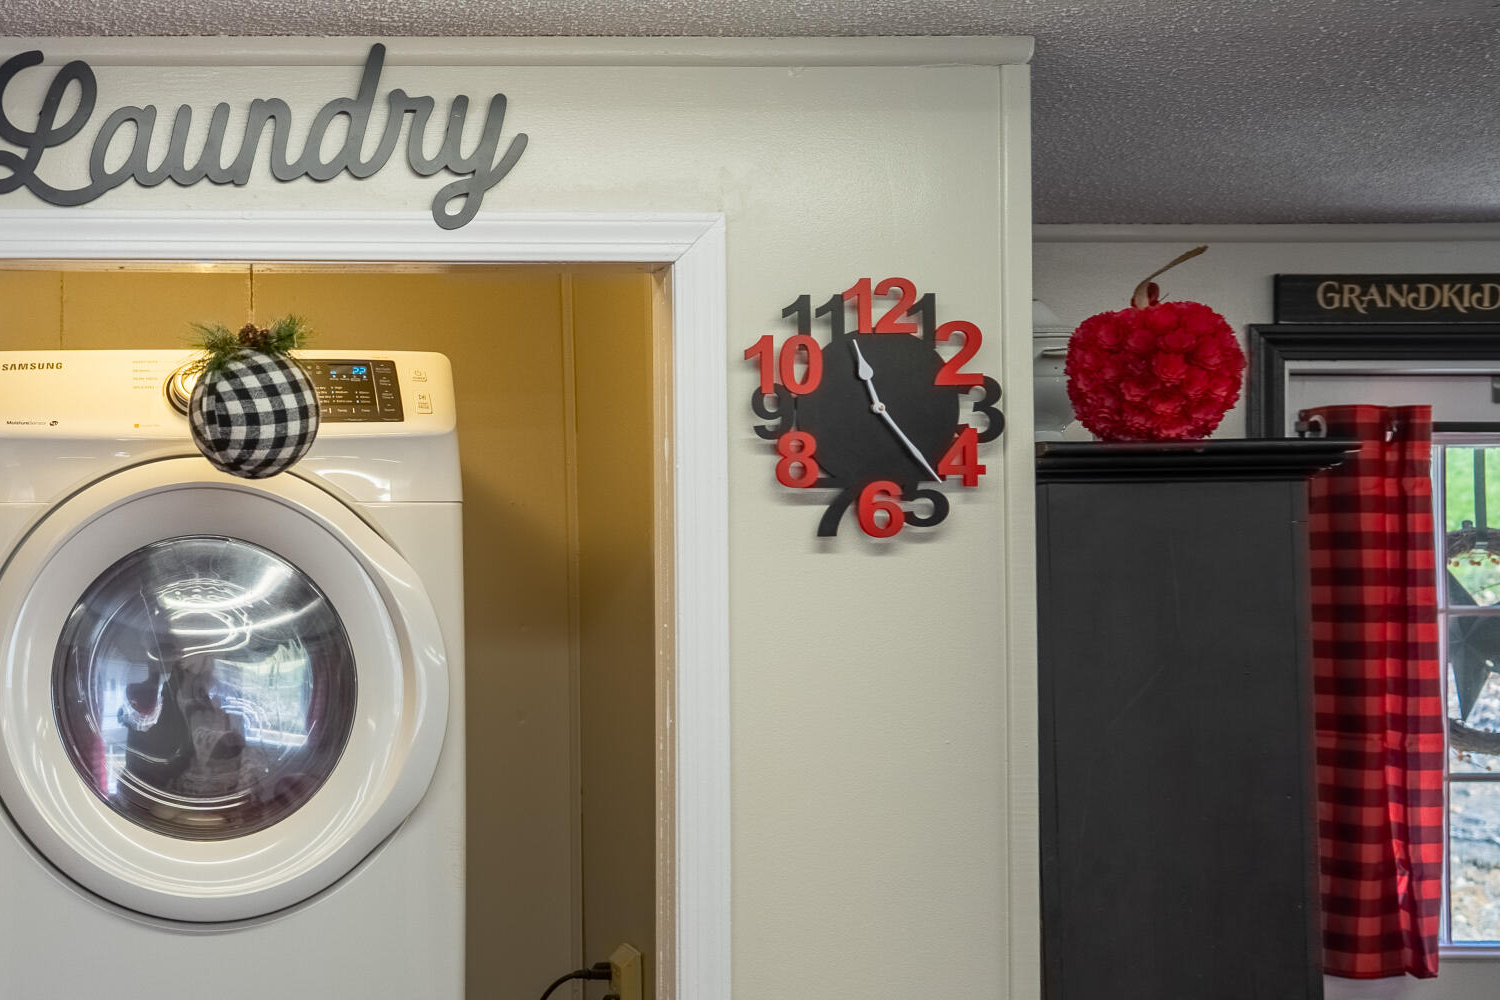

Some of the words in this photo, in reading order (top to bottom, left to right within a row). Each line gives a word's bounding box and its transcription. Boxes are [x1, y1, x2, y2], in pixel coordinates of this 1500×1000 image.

[781, 294, 846, 343] 11
[842, 277, 918, 334] 12
[907, 293, 936, 350] 1
[1316, 281, 1500, 314] GRANDKID
[1, 362, 63, 371] SAMSUNG
[744, 335, 823, 395] 10
[934, 320, 984, 386] 2
[751, 383, 795, 440] 9
[956, 376, 1005, 443] 3
[775, 431, 819, 489] 8
[937, 427, 986, 487] 4
[814, 477, 854, 537] 7
[857, 480, 904, 538] 6
[902, 481, 950, 528] 5
